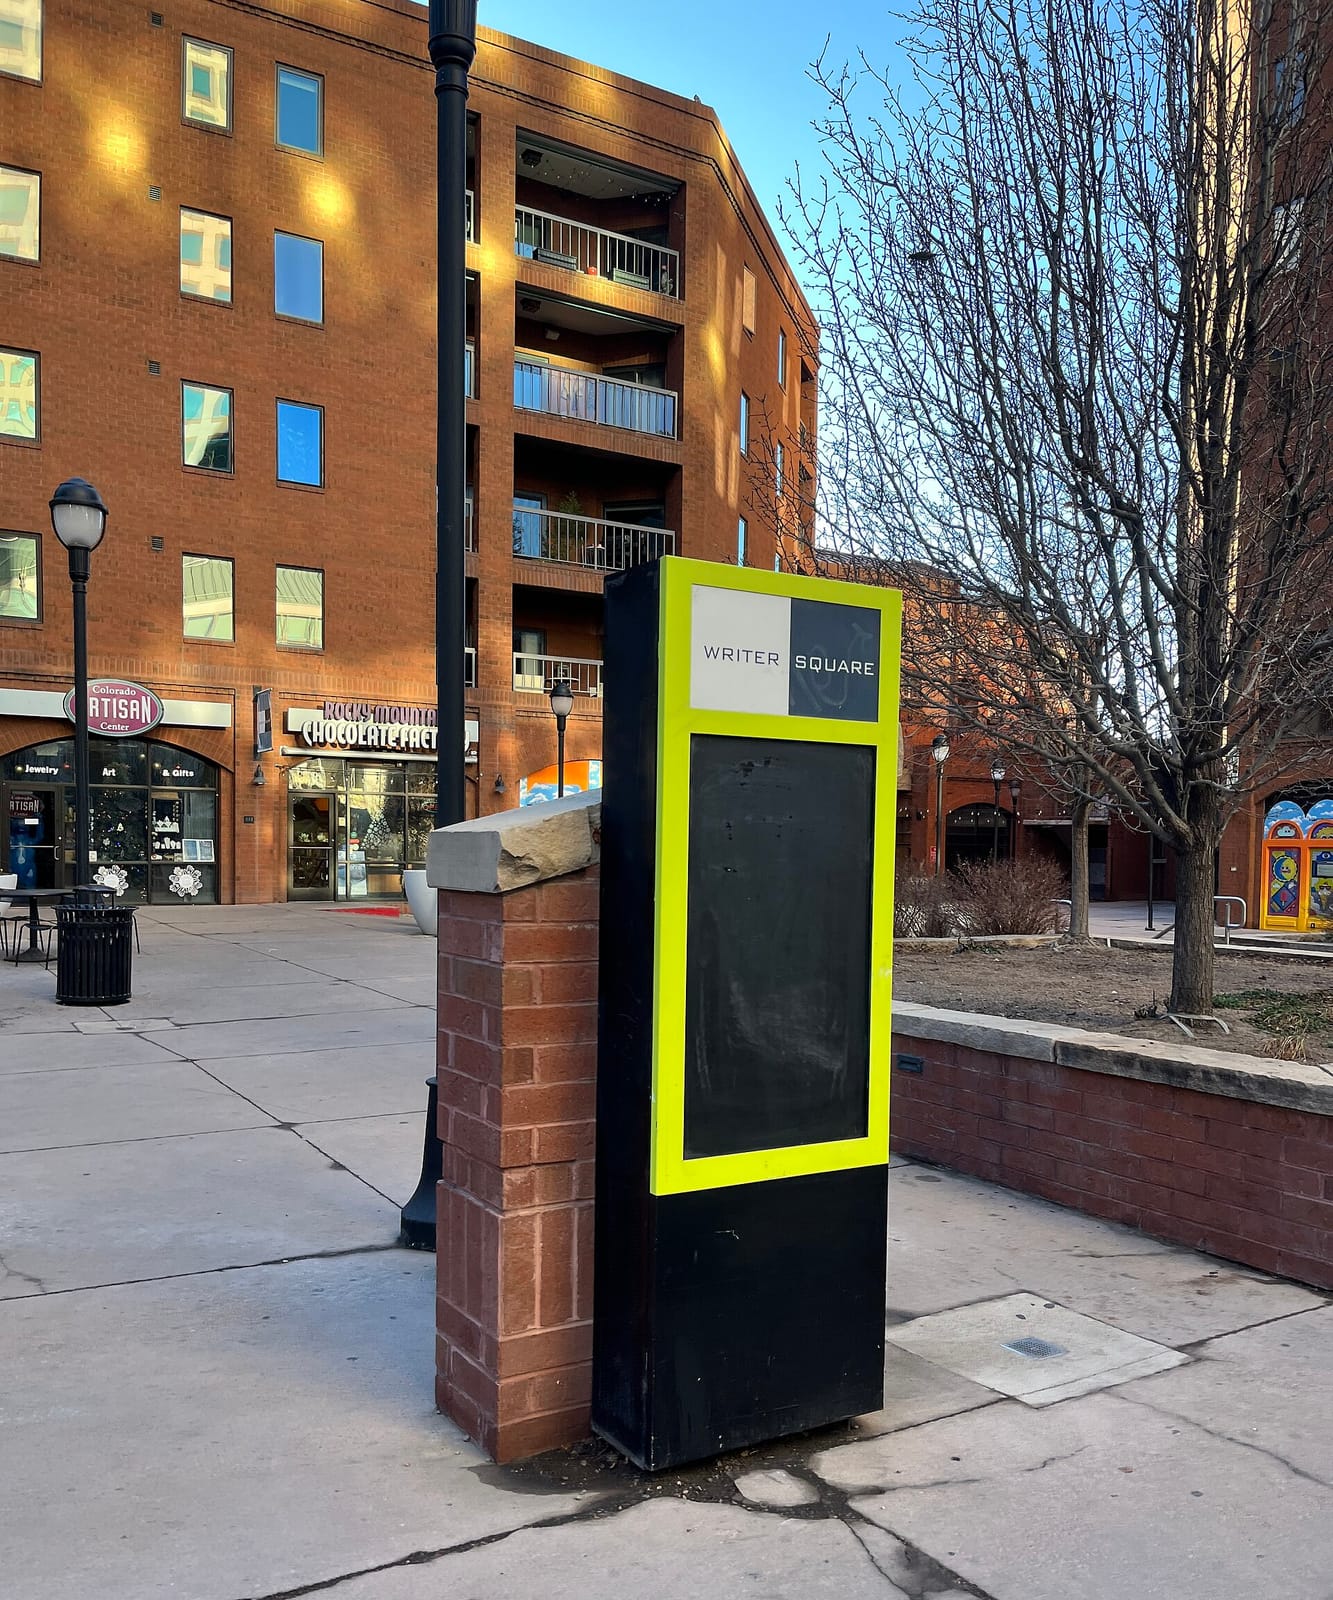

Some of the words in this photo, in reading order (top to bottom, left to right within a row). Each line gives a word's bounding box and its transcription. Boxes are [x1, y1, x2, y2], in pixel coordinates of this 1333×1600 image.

[703, 645, 780, 667] WRITER
[795, 655, 875, 676] SQUARE
[92, 685, 137, 696] Colorado
[88, 695, 152, 724] RTISAN
[323, 701, 371, 721] ROCKY
[373, 704, 438, 727] MOUNTA
[100, 721, 130, 731] Center
[301, 719, 399, 747] CHOCOLATE
[24, 764, 59, 776] Jewelry
[102, 767, 116, 777] Art
[162, 768, 170, 777] &
[172, 768, 195, 777] Gifts
